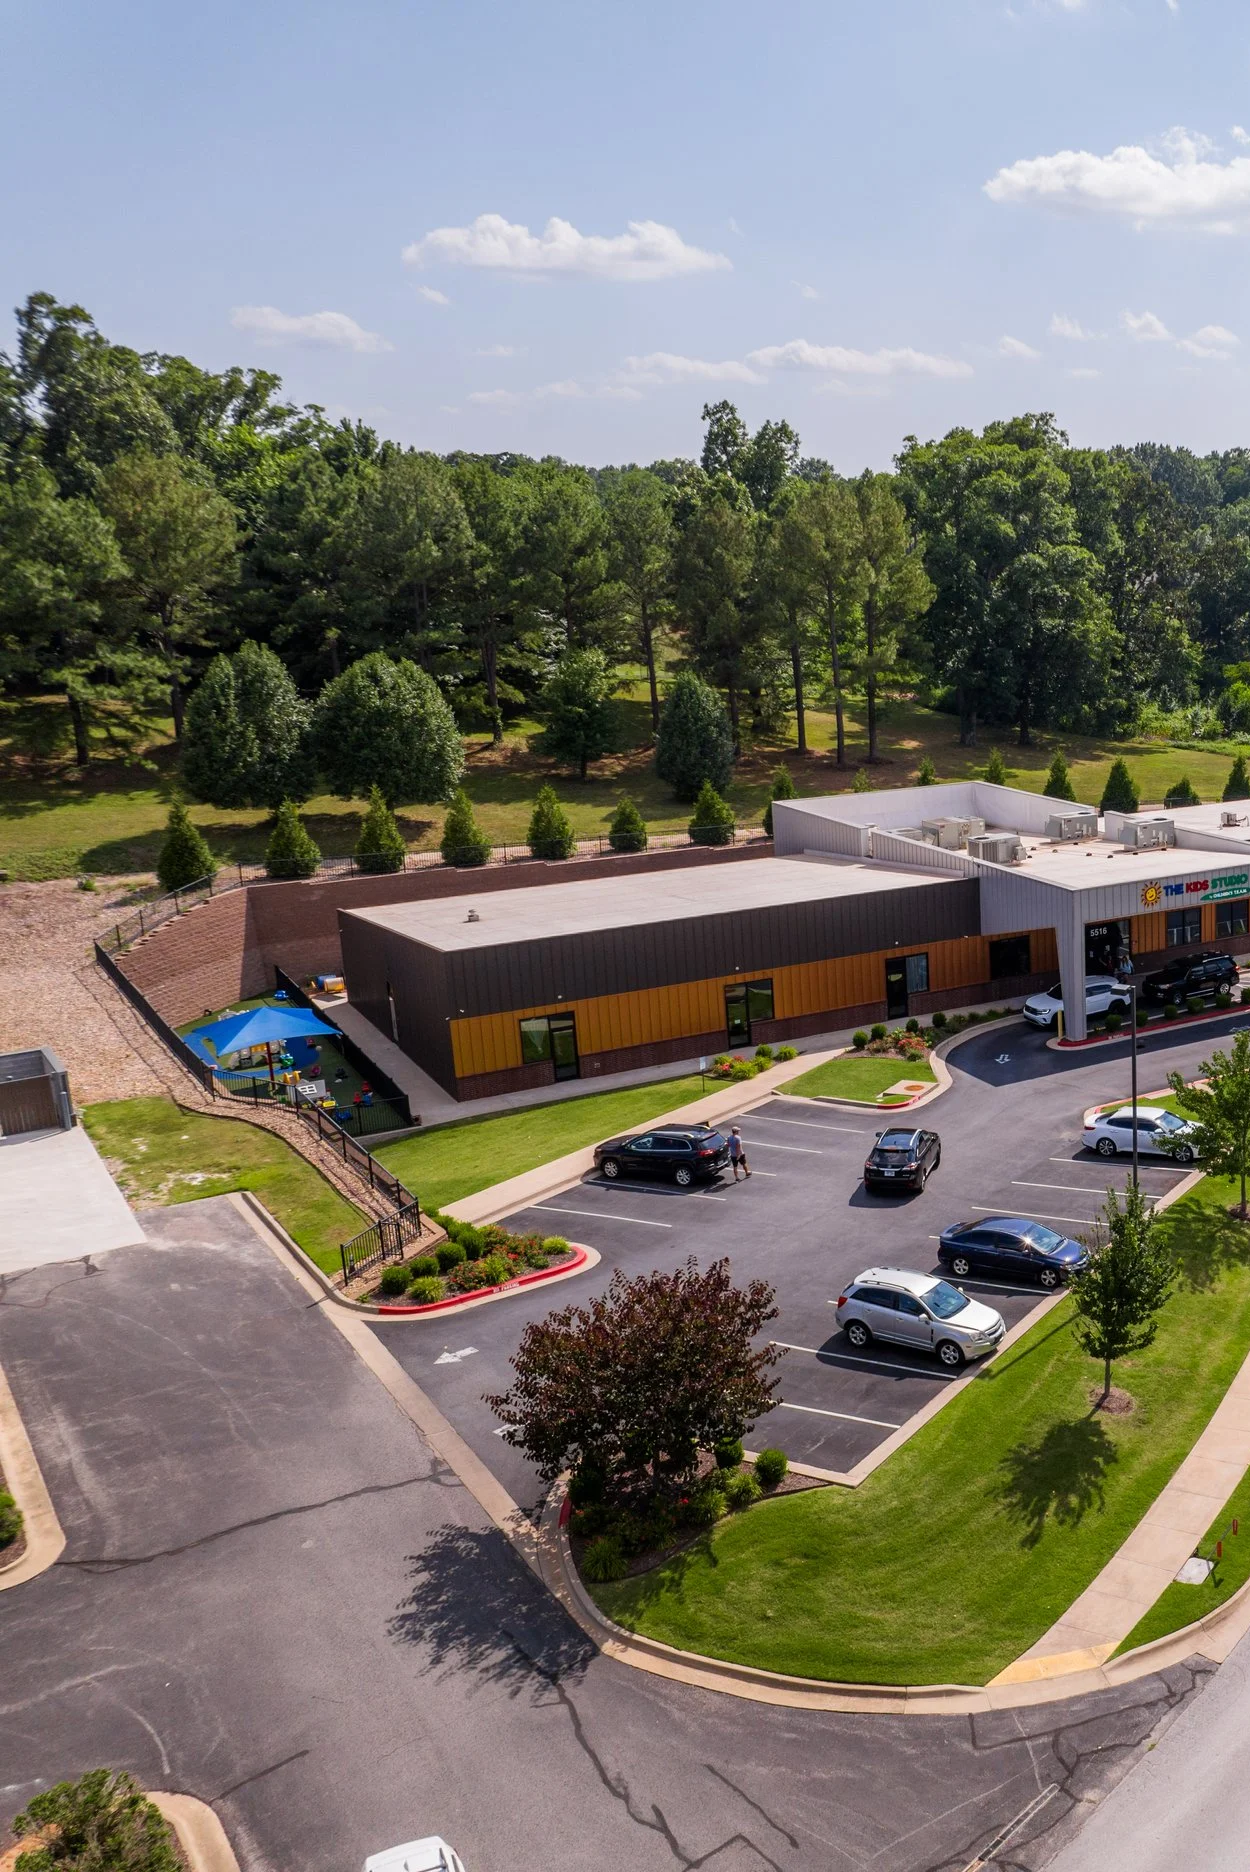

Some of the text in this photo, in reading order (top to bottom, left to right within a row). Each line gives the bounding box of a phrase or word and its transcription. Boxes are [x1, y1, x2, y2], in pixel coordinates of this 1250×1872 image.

[1163, 873, 1248, 896] THE KIDS STUDIO
[1090, 926, 1107, 937] 5516
